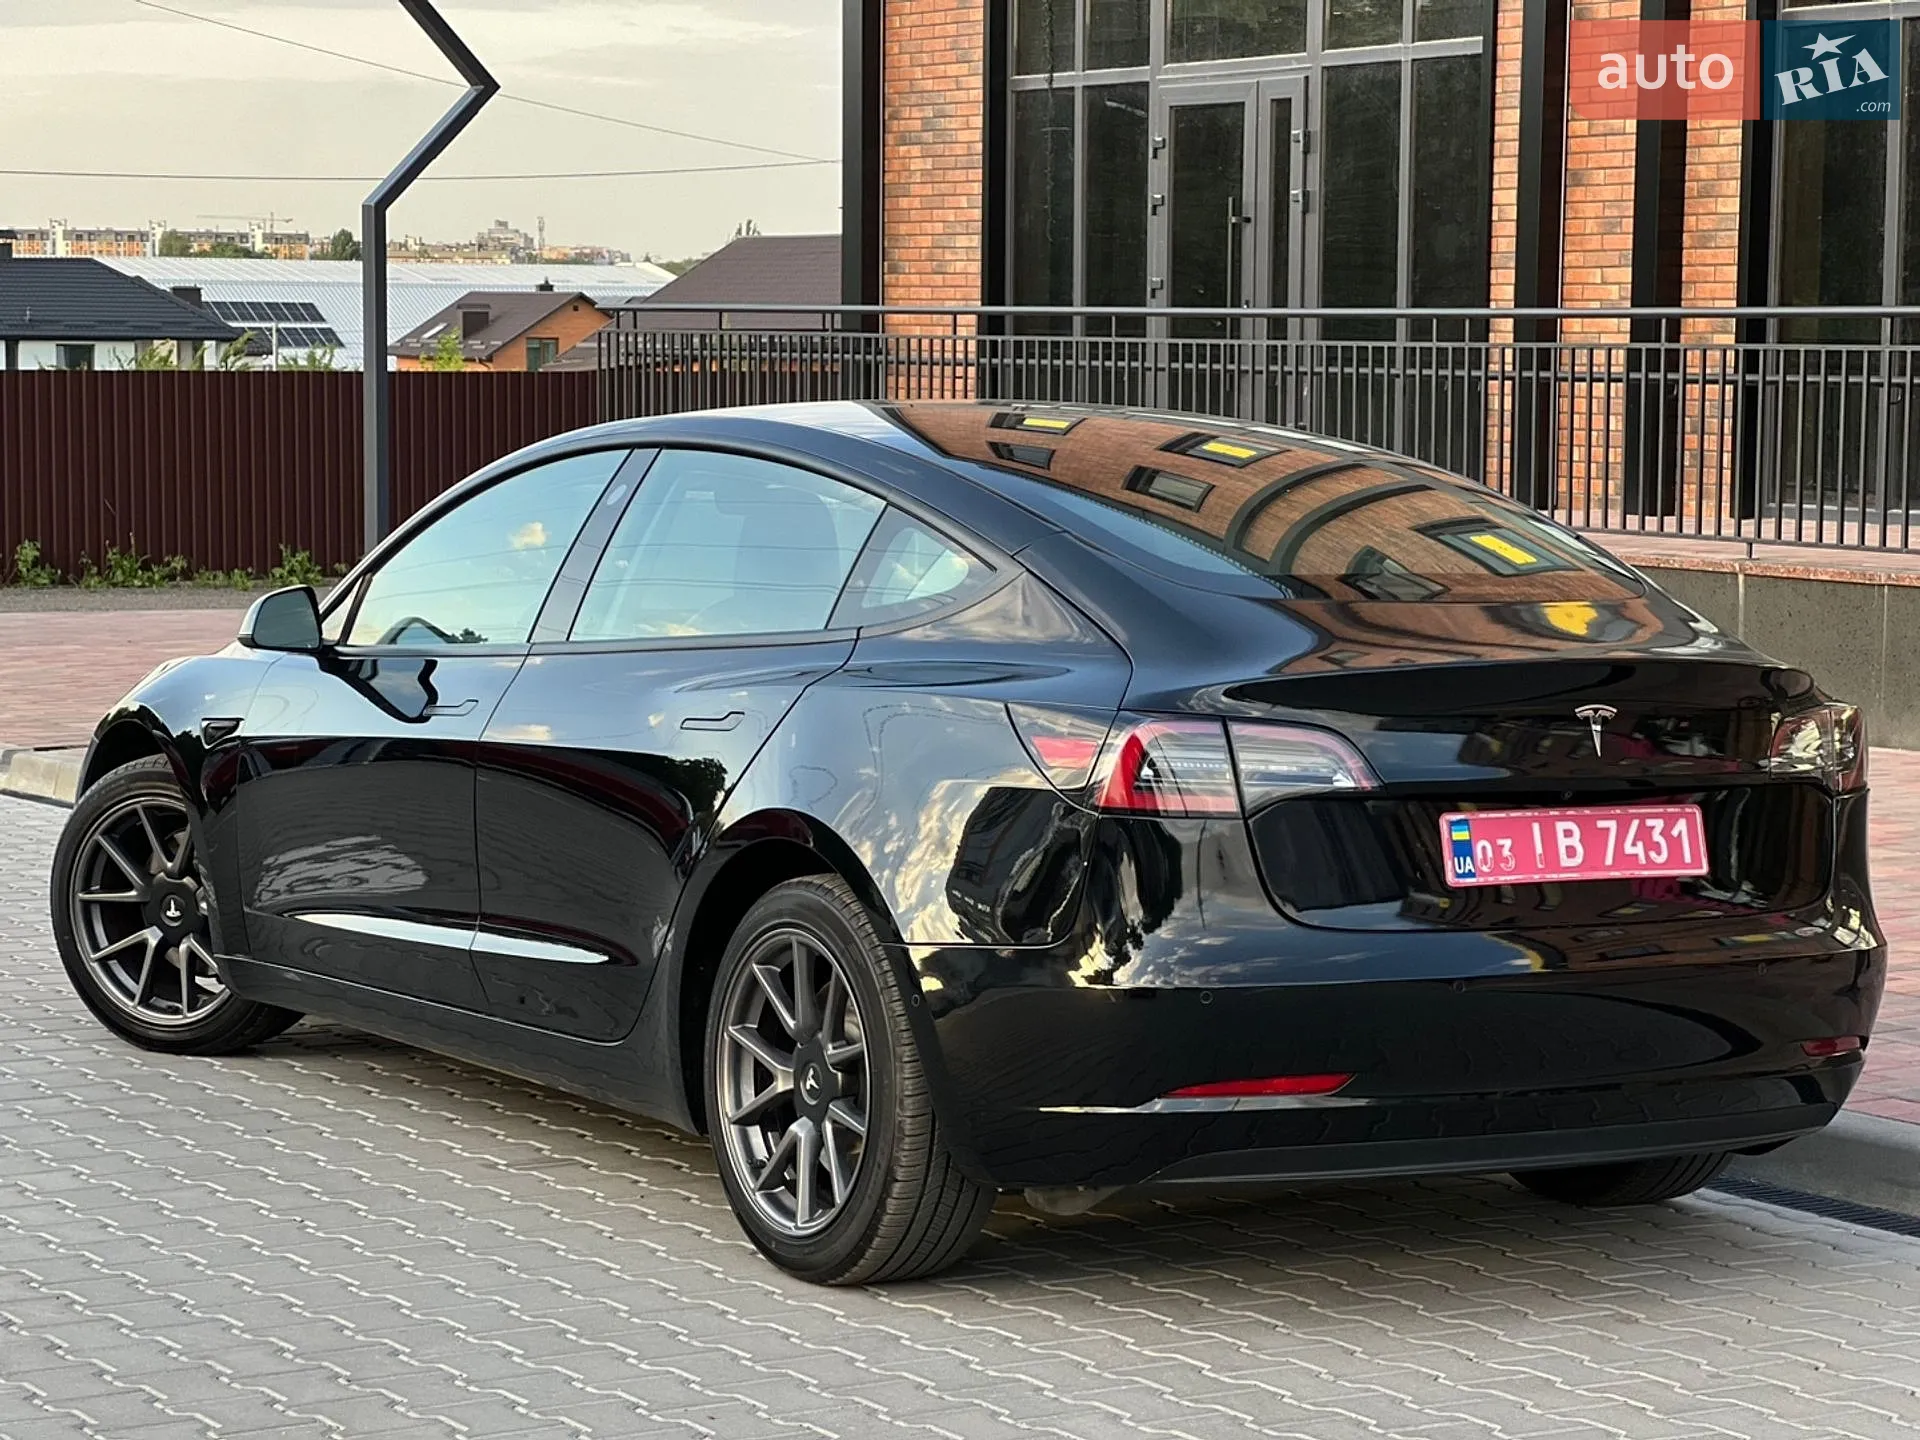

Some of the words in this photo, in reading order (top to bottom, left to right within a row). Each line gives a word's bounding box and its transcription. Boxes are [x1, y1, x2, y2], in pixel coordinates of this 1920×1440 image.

[1476, 838, 1515, 873] 03
[1596, 817, 1692, 866] 7431
[1455, 856, 1474, 874] UA
